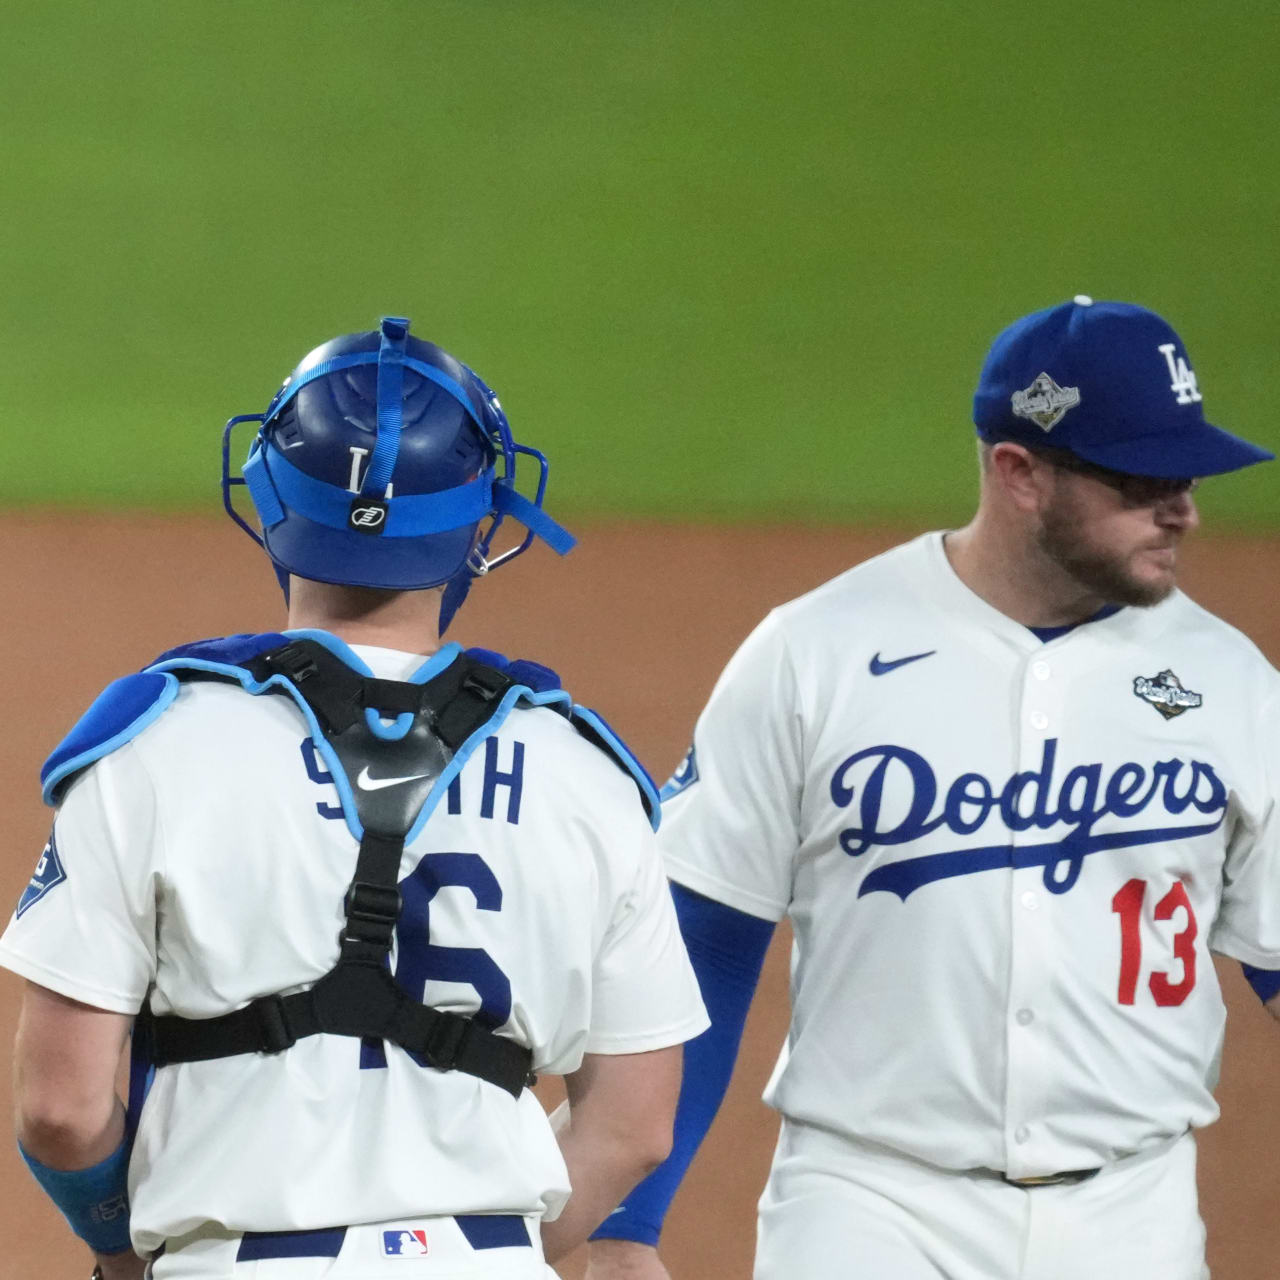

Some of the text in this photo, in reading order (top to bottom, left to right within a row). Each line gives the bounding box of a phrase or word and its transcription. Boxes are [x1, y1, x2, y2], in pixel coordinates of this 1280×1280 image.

[1158, 343, 1202, 404] LA
[345, 446, 393, 499] L
[831, 738, 1228, 896] Dodgers
[1112, 878, 1198, 1007] 13
